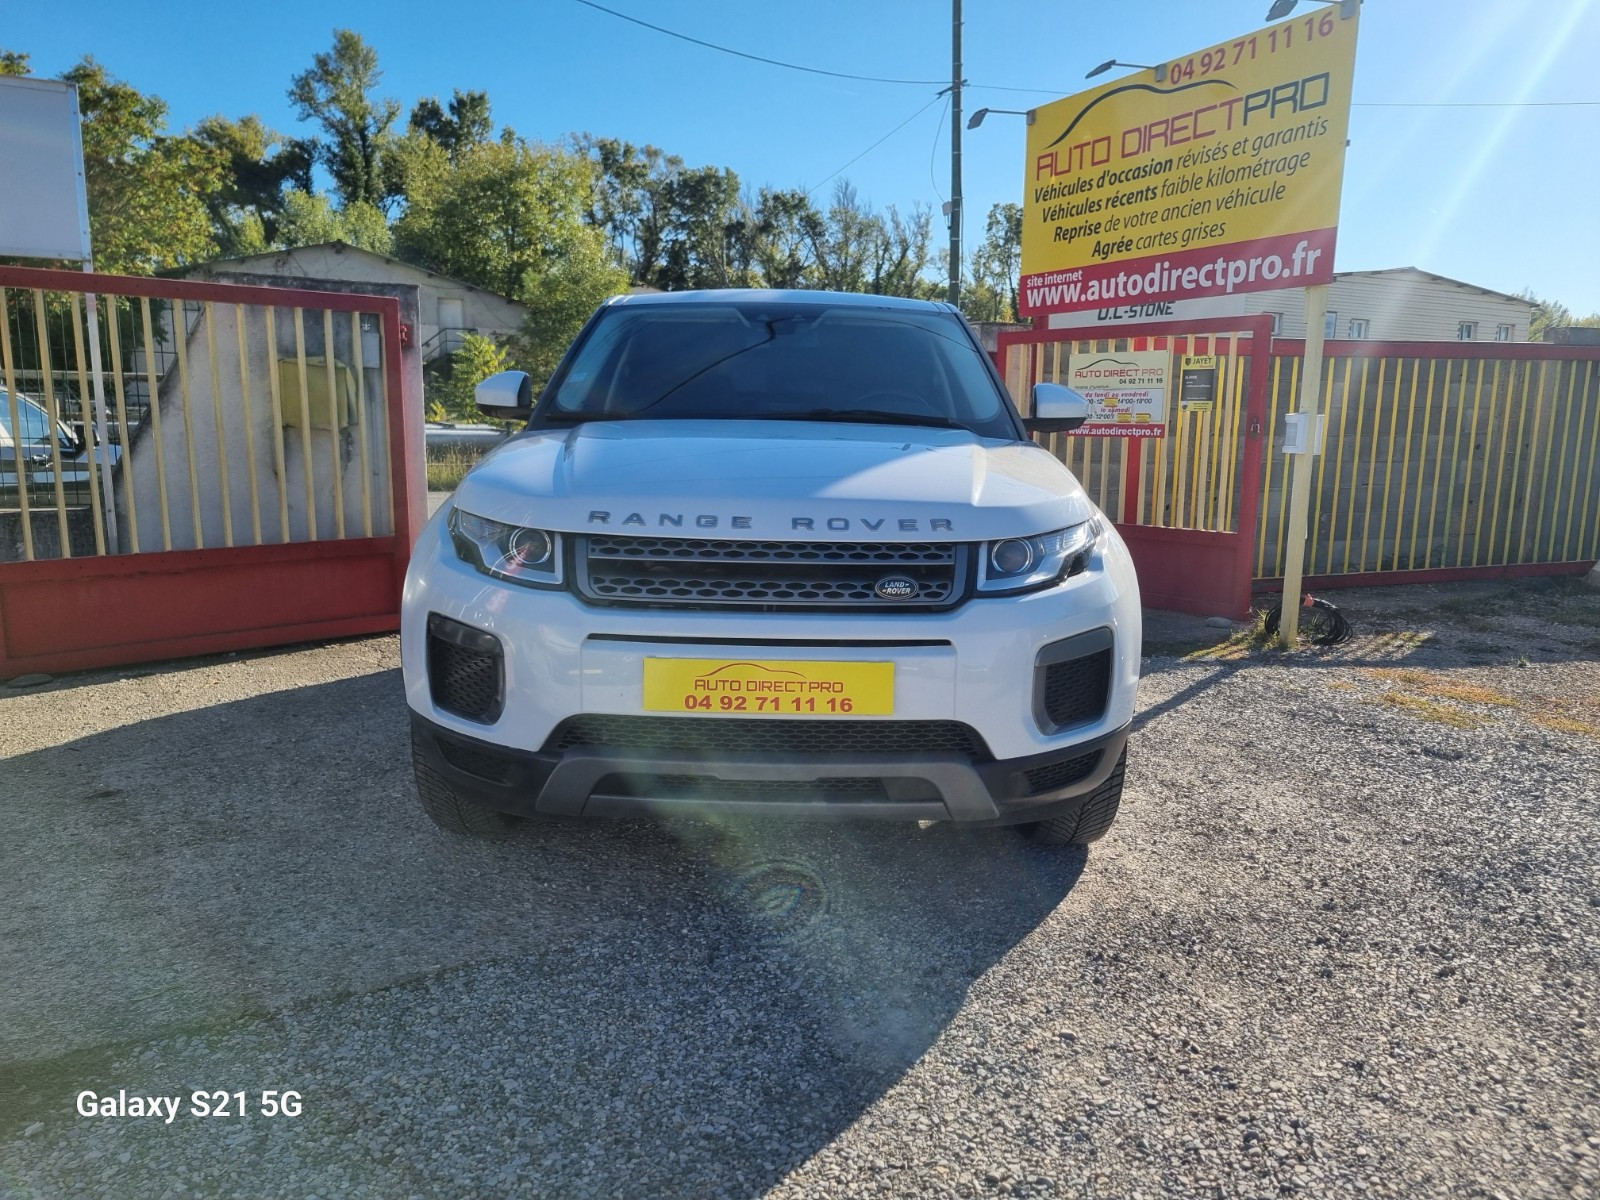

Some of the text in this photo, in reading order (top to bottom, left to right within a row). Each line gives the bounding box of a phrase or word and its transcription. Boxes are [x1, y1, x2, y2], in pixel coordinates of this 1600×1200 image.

[1171, 11, 1334, 85] 04 92 71 11 16
[1034, 117, 1329, 204] Véhicules d'occasion révisés et garantis
[1036, 136, 1111, 181] AUTO
[1042, 150, 1311, 224] Véhicules récents faible kilométrage
[1054, 181, 1286, 243] Reprise de votre ancien véhicule
[1092, 220, 1226, 259] Agrée cartes grises
[1026, 240, 1322, 308] www.autodirectpro.fr
[1027, 270, 1083, 288] site internet
[1075, 370, 1101, 378] AUTO
[1068, 427, 1162, 436] www.autodirectpro.fr
[587, 510, 955, 532] RANGE ROVER
[684, 695, 853, 713] 04 92 71 11 16
[694, 679, 742, 691] AUTO
